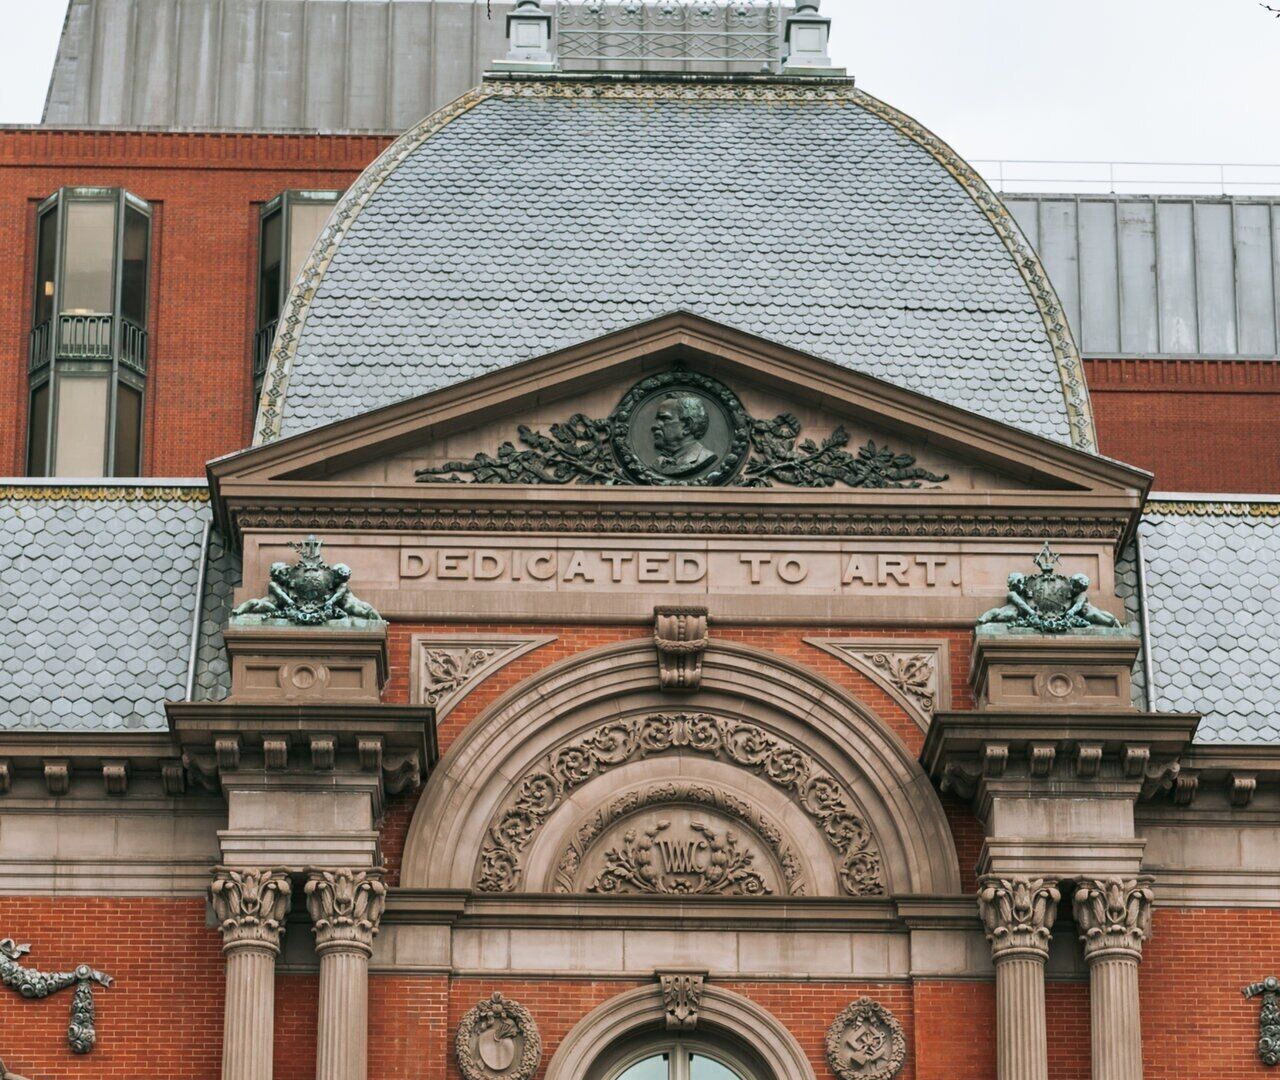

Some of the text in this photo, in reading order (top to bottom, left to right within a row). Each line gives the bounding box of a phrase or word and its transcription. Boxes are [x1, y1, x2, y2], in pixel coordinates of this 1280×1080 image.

[400, 550, 961, 587] DEDICATED TO ART.
